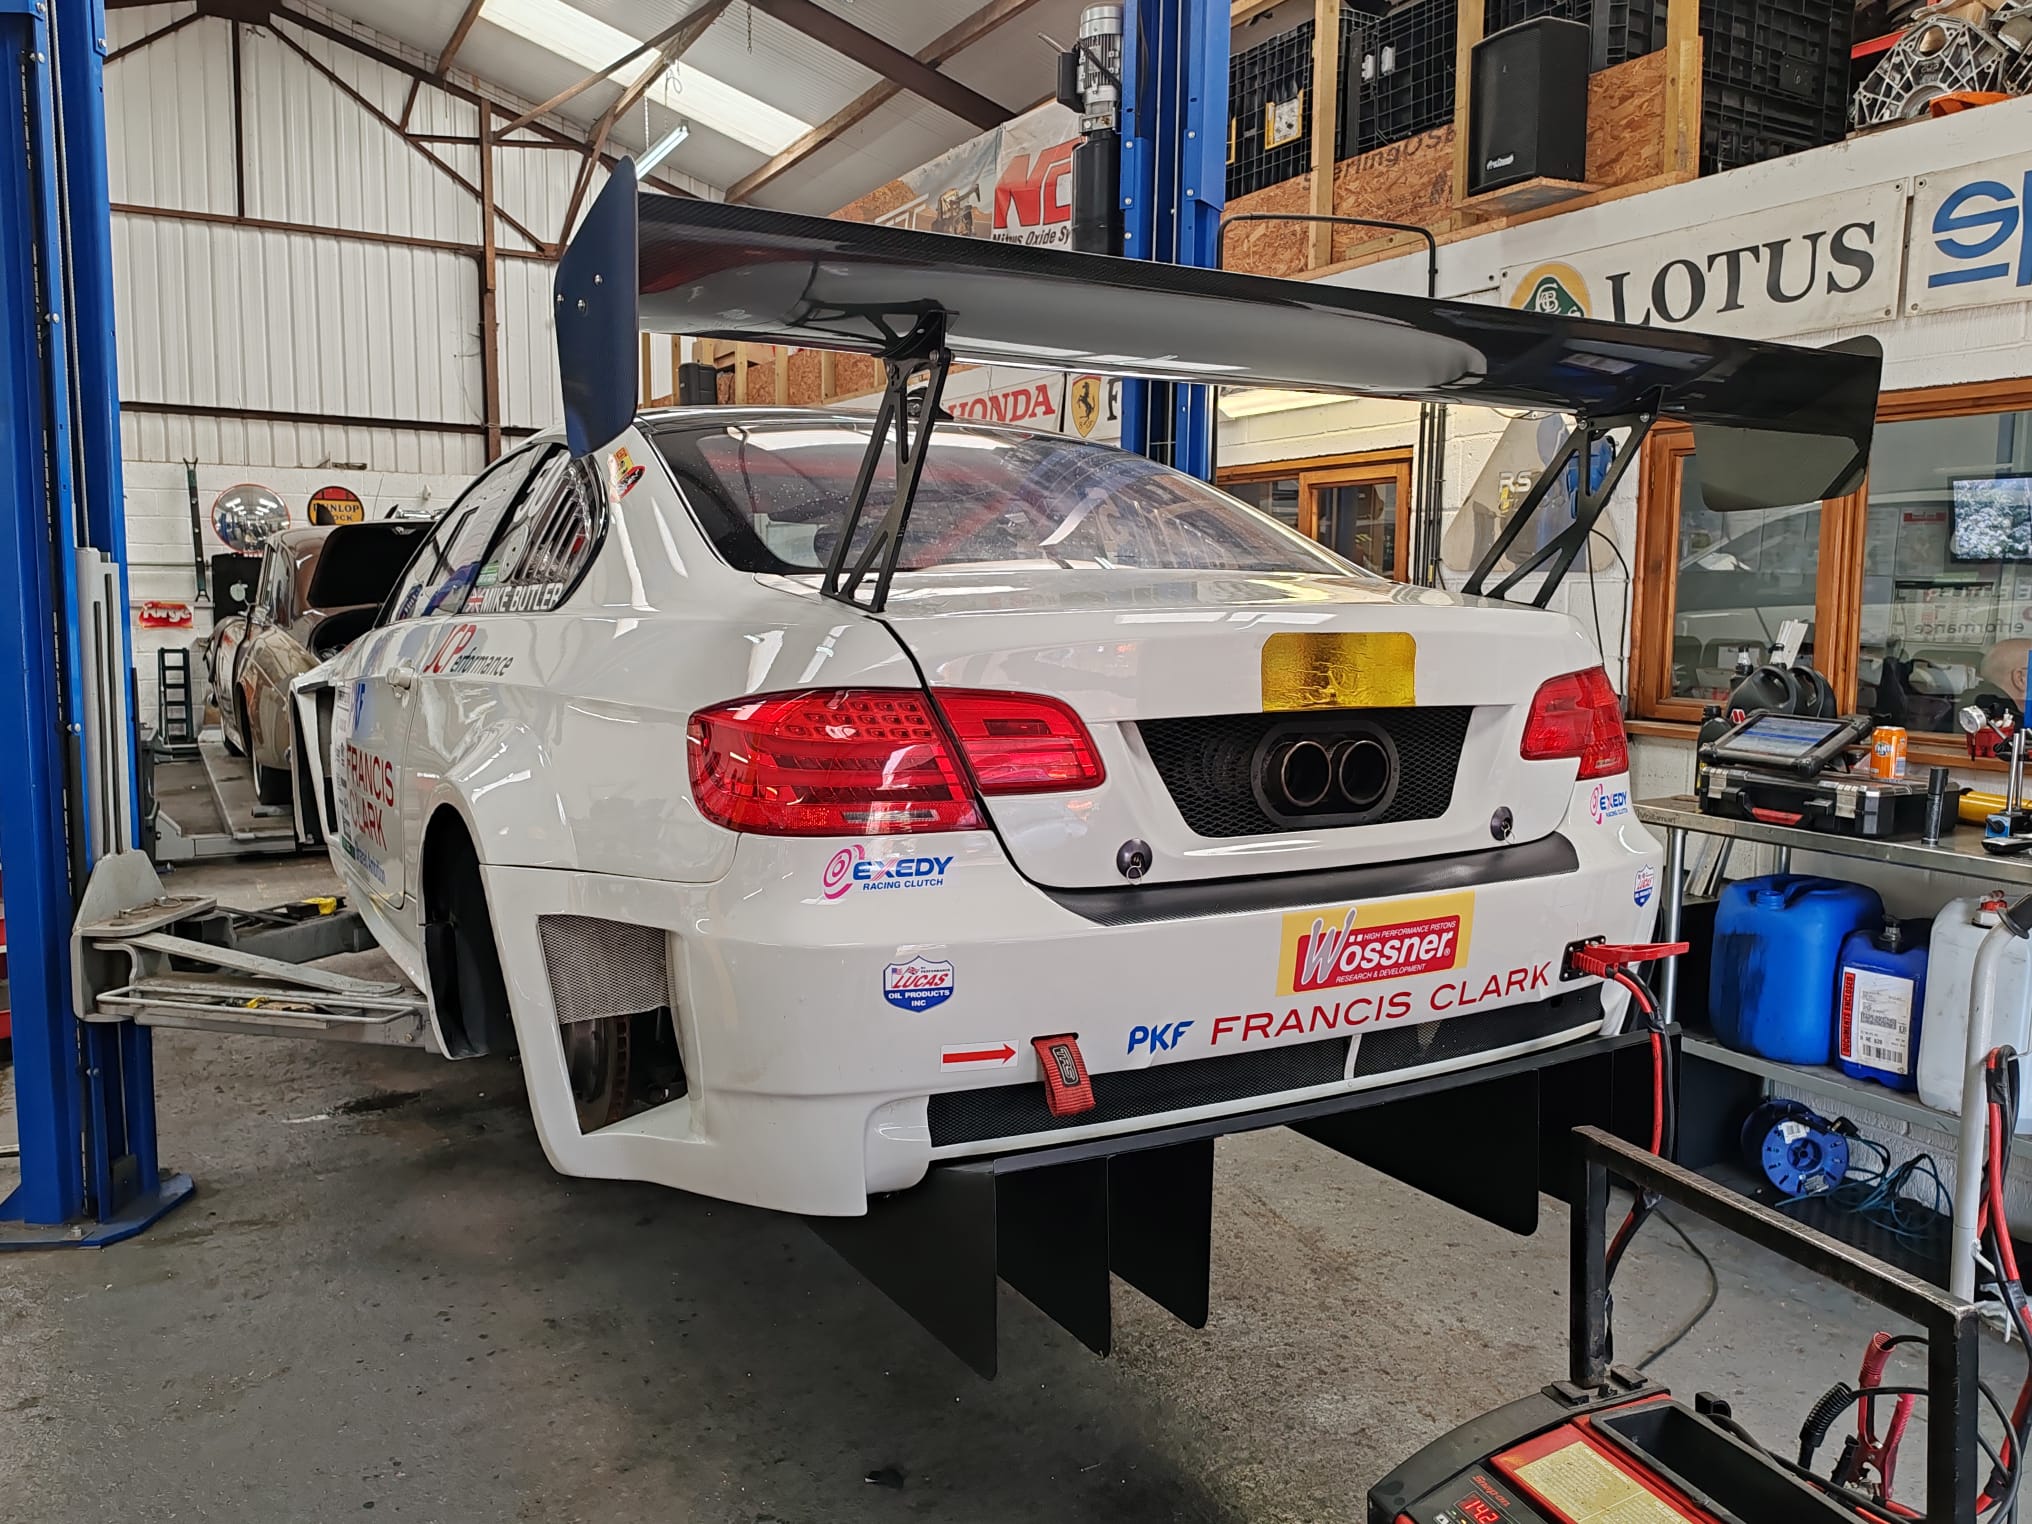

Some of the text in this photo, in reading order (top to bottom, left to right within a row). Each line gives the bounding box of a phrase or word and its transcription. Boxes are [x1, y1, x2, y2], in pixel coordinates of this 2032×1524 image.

[1025, 228, 1057, 246] Oxide
[1604, 221, 1876, 327] LOTUS
[948, 383, 1055, 423] HONDA
[313, 503, 360, 513] NLOP
[481, 582, 563, 613] MIKE BUTLER
[143, 602, 191, 622] Forge
[346, 743, 394, 808] FRANCIS
[1600, 791, 1628, 811] EXEDY
[350, 789, 387, 851] CLARK
[853, 856, 954, 882] EXEDY
[863, 879, 943, 891] RACING CLUTCH
[1363, 920, 1456, 941] HIGH PERFORMANCE PISTONS
[892, 973, 949, 989] LUCAS
[1336, 963, 1426, 984] RESEARCH & DEVELOPMENT
[904, 989, 951, 999] PRODUCTS
[1211, 961, 1552, 1046] FRANCIS CLARK
[1841, 975, 1853, 1053] DOCUMENTS ENCLOSED
[1127, 1020, 1195, 1056] PKF
[1471, 1474, 1511, 1508] Snap-on
